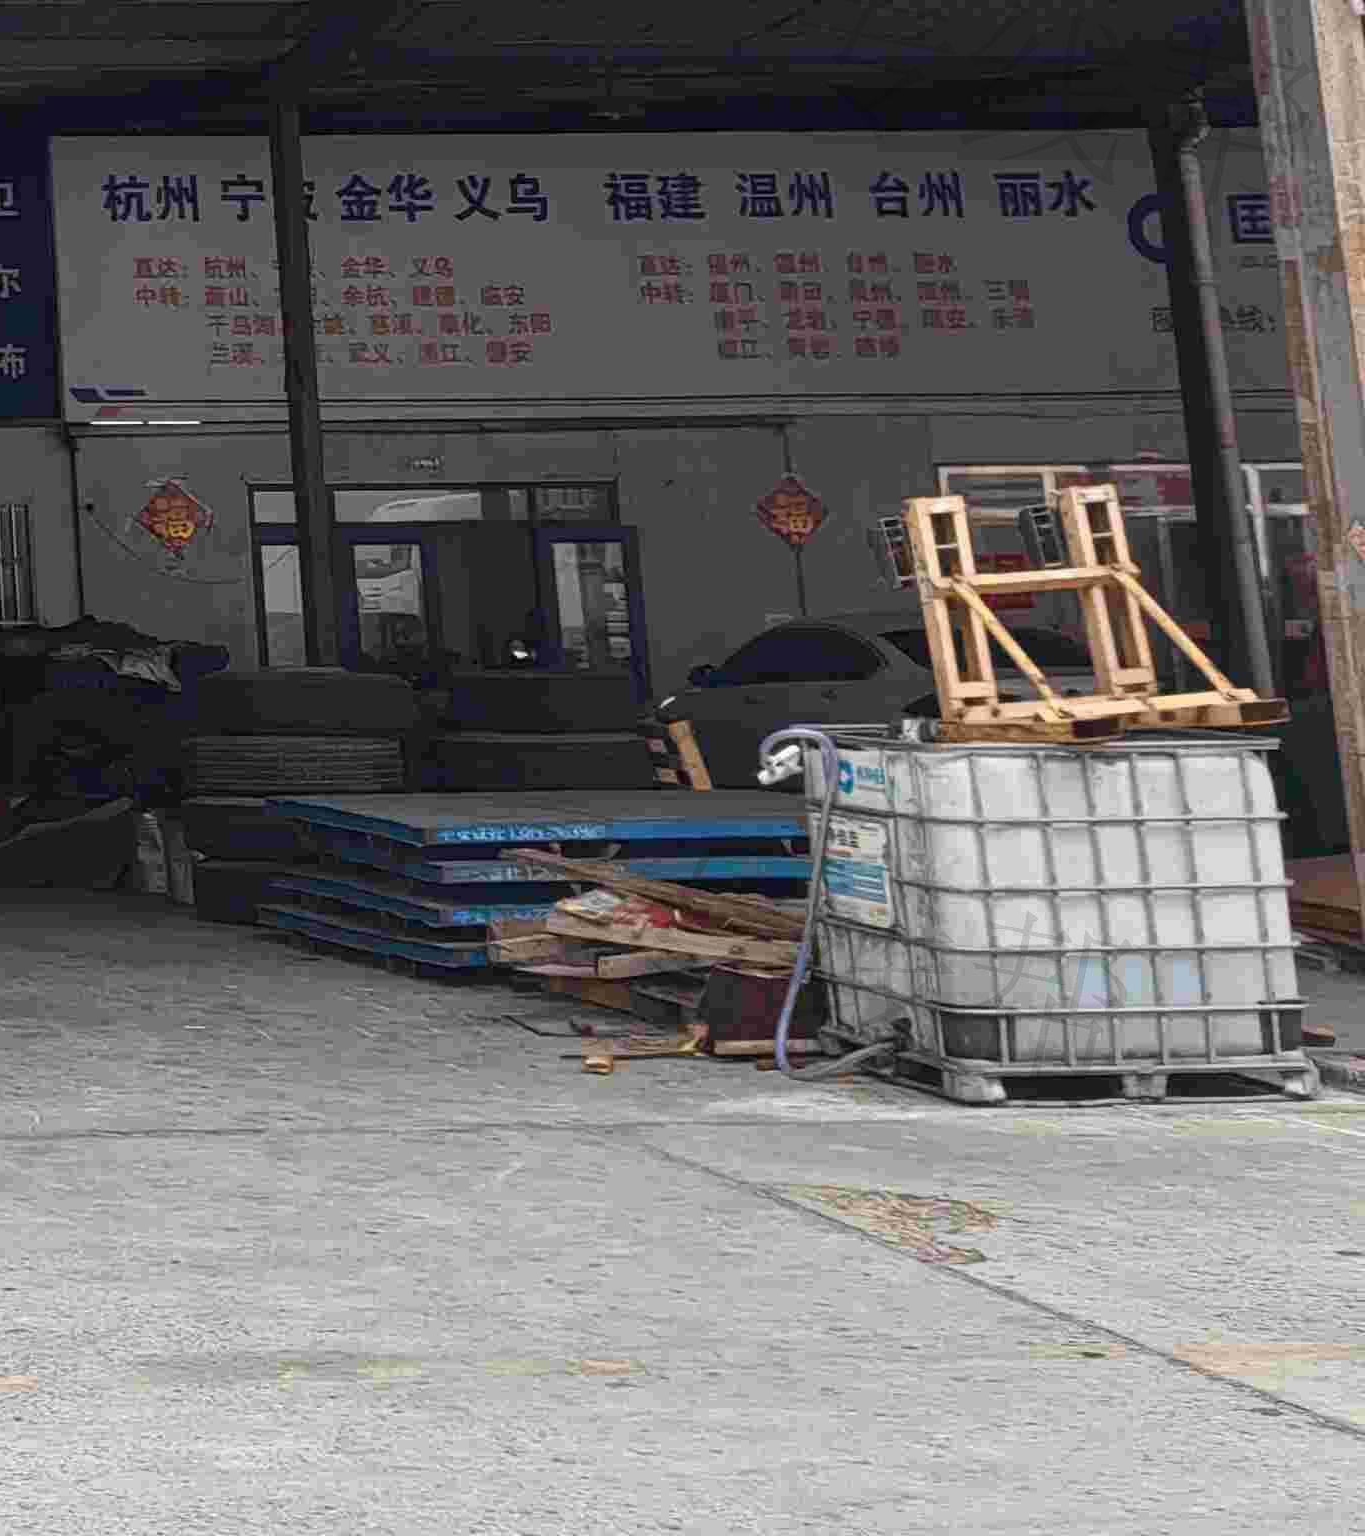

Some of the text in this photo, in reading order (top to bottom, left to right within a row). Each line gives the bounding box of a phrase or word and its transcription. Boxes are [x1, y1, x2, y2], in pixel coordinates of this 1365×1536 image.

[101, 174, 202, 223] 杭州
[336, 173, 436, 223] 金华
[455, 173, 550, 222] 义乌
[604, 172, 706, 221] 福建
[735, 171, 836, 220] 温州
[869, 171, 966, 220] 台州
[993, 170, 1097, 218] 丽水
